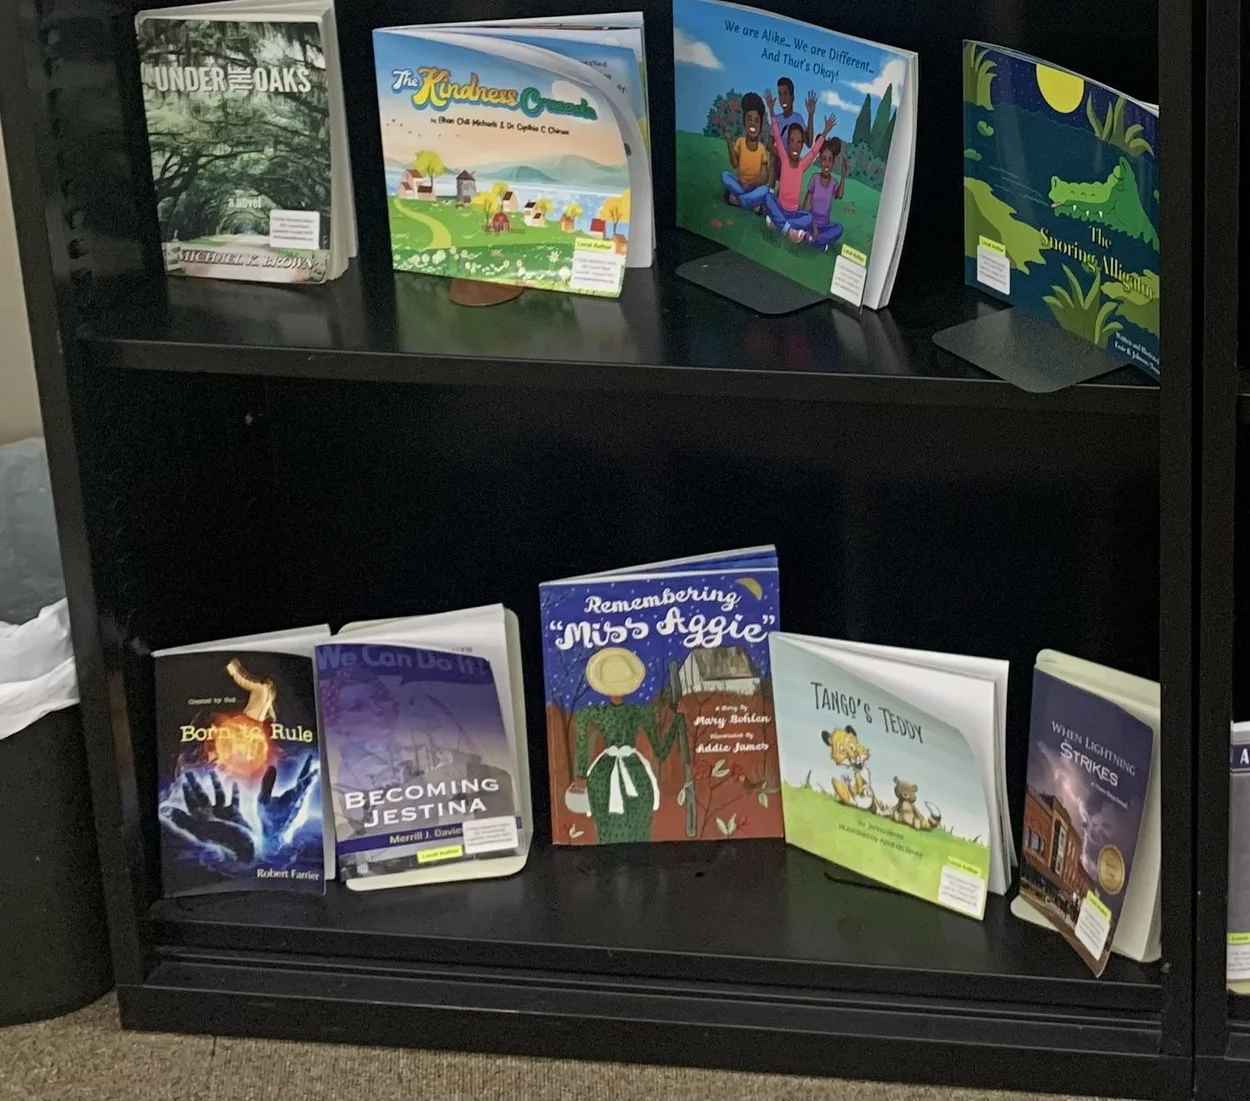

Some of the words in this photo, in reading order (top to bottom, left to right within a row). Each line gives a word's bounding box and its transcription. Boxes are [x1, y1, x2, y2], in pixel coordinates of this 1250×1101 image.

[725, 19, 740, 34] We
[742, 27, 759, 39] are
[794, 38, 810, 54] We
[810, 43, 826, 55] are
[154, 66, 229, 92] UNDER
[229, 66, 251, 91] THE
[254, 66, 311, 93] OAKS
[761, 48, 780, 62] And
[782, 52, 811, 73] That's
[813, 63, 839, 84] Okay!
[392, 68, 420, 89] The
[413, 67, 518, 108] Kindness
[236, 196, 262, 209] novel
[1040, 227, 1099, 274] Snoring
[1089, 225, 1113, 249] The
[263, 254, 313, 270] BROWN
[1099, 254, 1156, 300] Alligator
[584, 586, 741, 615] Remembering
[317, 647, 358, 671] We
[361, 646, 411, 669] Can
[417, 650, 450, 672] Do
[693, 716, 727, 729] Mary
[811, 681, 873, 724] TANGO'S
[879, 706, 924, 744] TEDDY
[179, 724, 231, 743] Born
[271, 724, 313, 743] Rule
[1051, 720, 1082, 745] WHEN
[1085, 737, 1136, 777] LIGHTNING
[1240, 749, 1250, 765] A
[1060, 742, 1119, 787] STRIKES
[345, 778, 500, 810] BECOMING
[363, 799, 487, 828] JESTINA
[389, 831, 424, 844] Merrill
[424, 830, 432, 841] J.
[257, 868, 288, 879] Robert
[291, 869, 319, 881] Farrier
